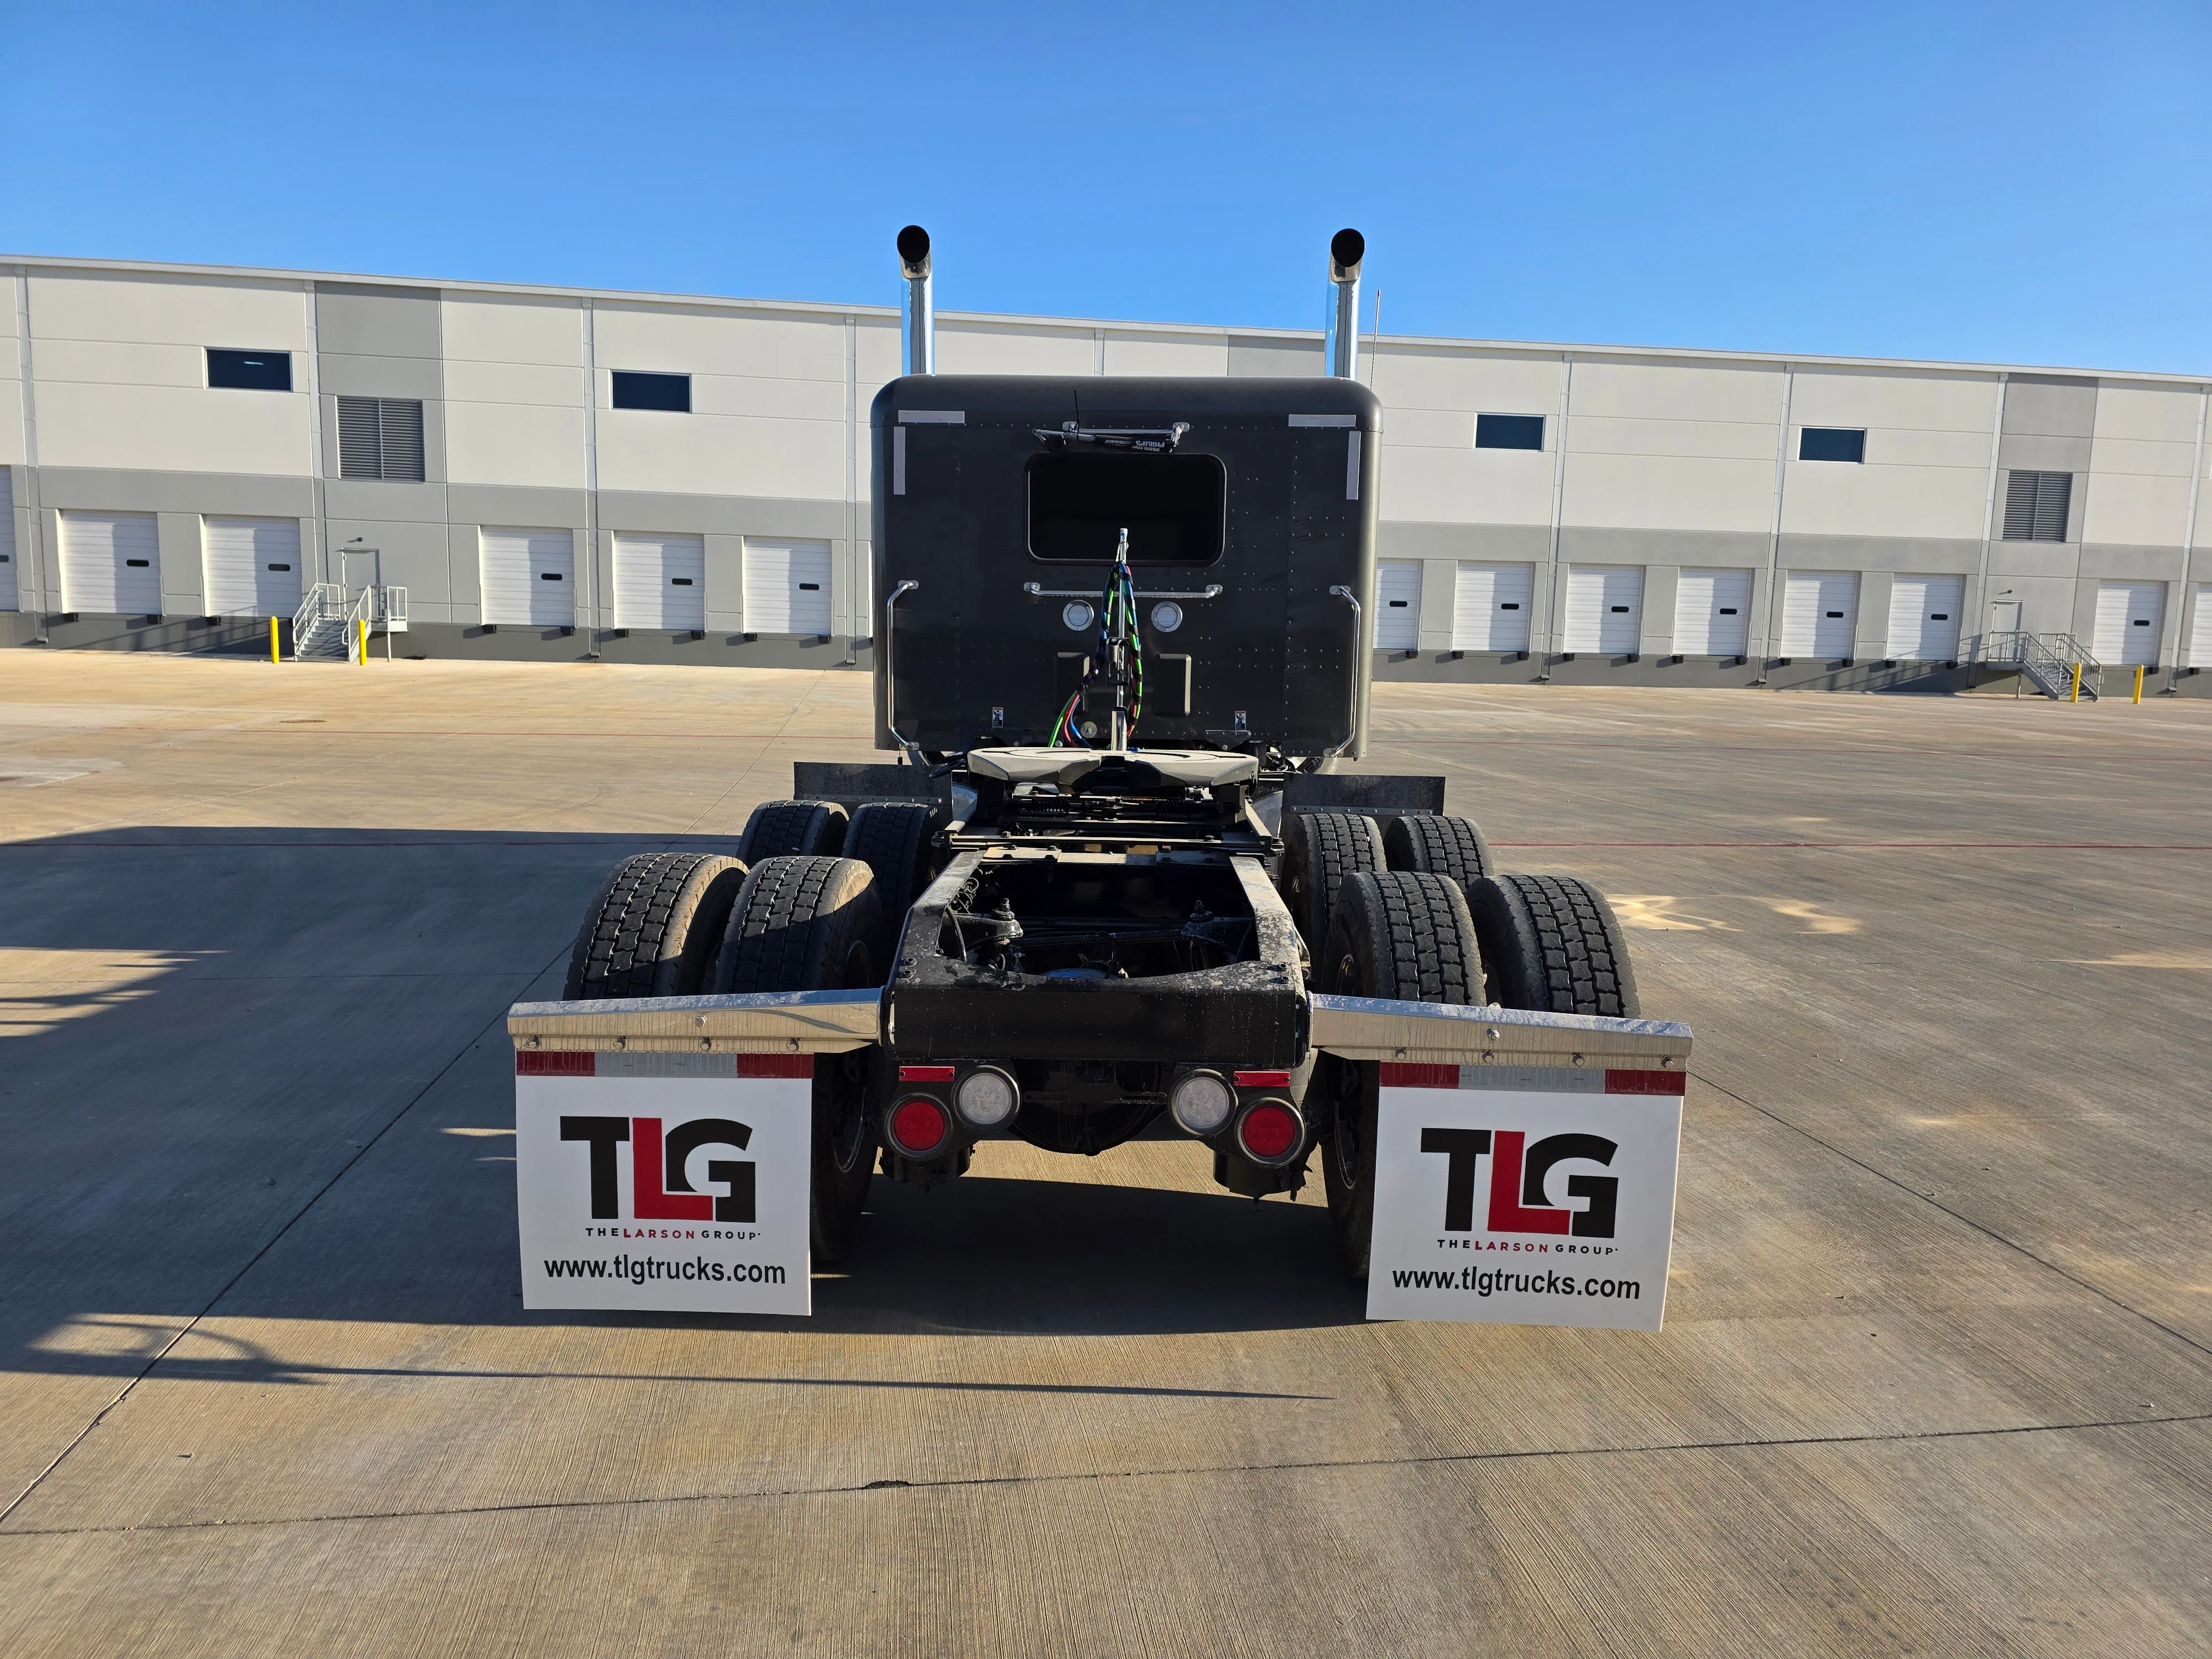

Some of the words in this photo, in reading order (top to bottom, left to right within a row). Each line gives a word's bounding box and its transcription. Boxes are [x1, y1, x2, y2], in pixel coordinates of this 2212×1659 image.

[560, 1116, 756, 1223] TLG
[1421, 1128, 1619, 1239] TLG
[701, 1230, 756, 1240] GROUP
[1555, 1244, 1613, 1255] GROUP
[544, 1254, 786, 1285] www.tlgtrucks.com
[1392, 1266, 1640, 1300] www.tlgtrucks.com
